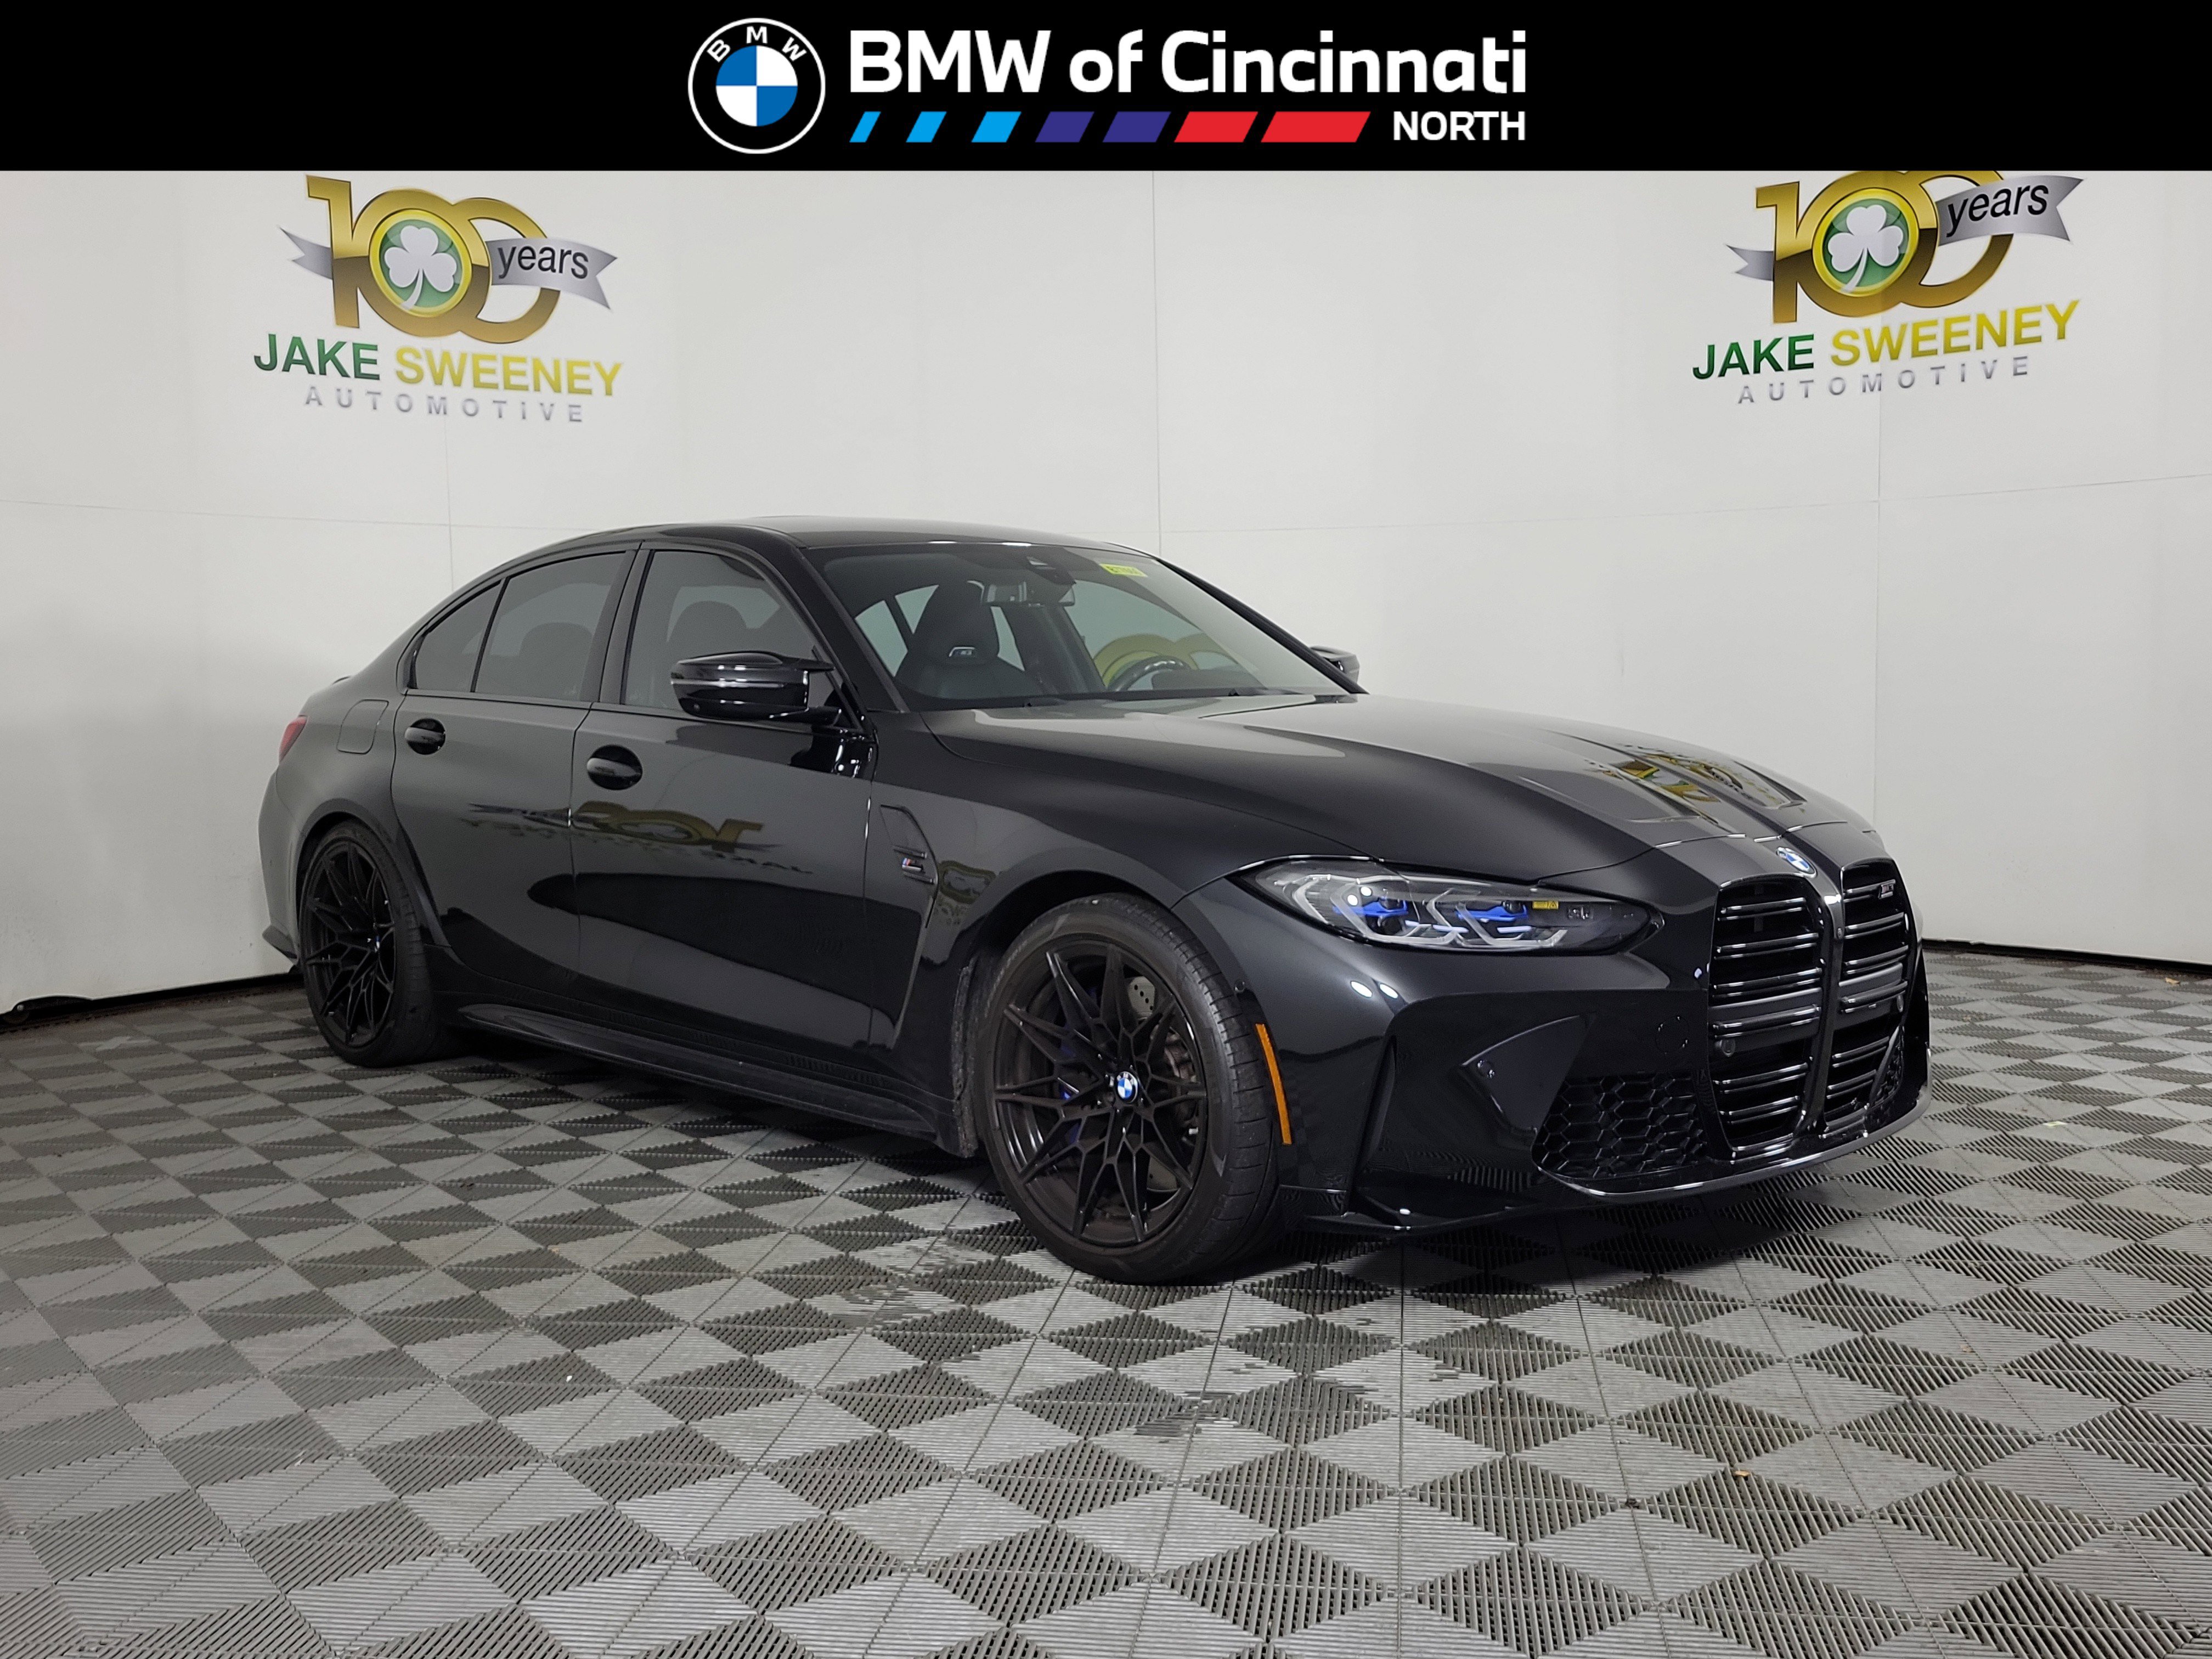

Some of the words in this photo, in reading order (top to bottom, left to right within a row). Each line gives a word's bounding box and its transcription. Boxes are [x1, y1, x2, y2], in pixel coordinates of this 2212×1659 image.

[306, 174, 560, 344] 100
[498, 245, 590, 279] years
[1756, 171, 2014, 324] 100
[1945, 184, 2049, 238] years
[253, 333, 380, 380] JAKE
[394, 347, 622, 396] SWEENEY
[1692, 334, 1815, 380] JAKE
[1830, 299, 2080, 367] SWEENEY
[304, 386, 583, 422] AUTOMOTIVE
[1737, 356, 2029, 404] AUTOMOTIVE
